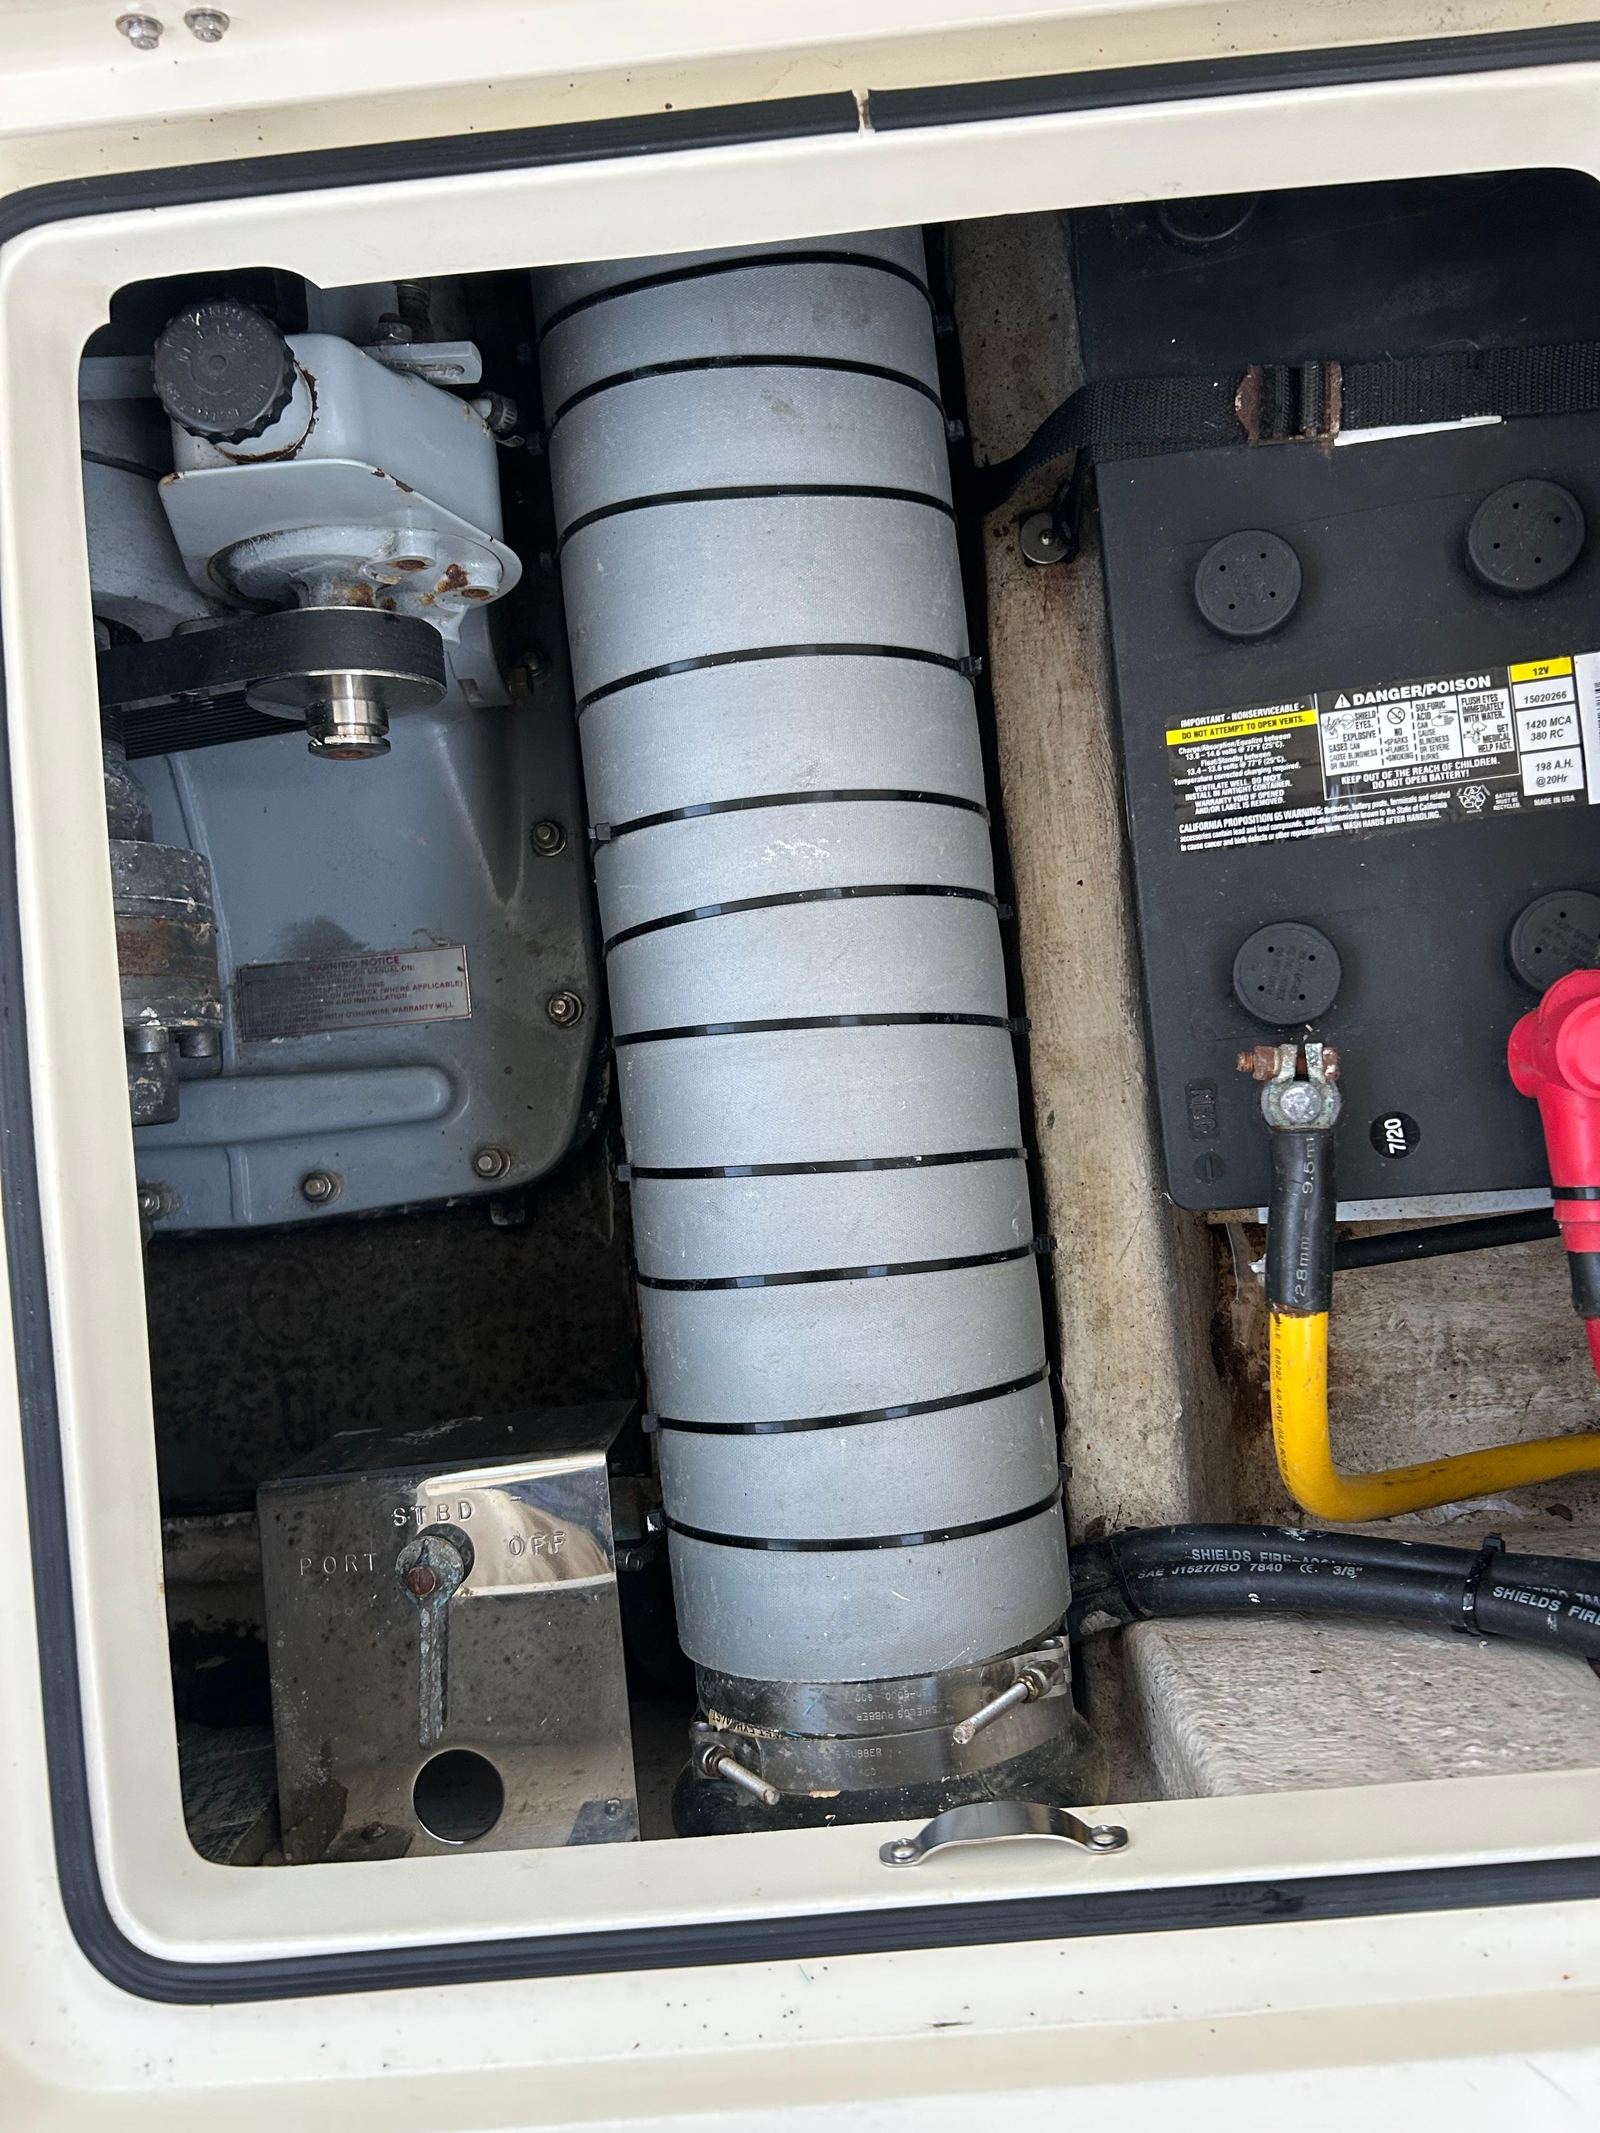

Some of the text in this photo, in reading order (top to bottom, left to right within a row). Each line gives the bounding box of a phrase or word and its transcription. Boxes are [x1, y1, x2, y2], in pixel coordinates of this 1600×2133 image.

[1533, 666, 1549, 676] 12V
[1353, 675, 1491, 706] DANGER/POISON
[1462, 693, 1498, 705] FLUSH EYES
[1524, 691, 1566, 704] 15020266
[1416, 701, 1446, 712] SULFURIC
[1462, 701, 1504, 714] IMMEDIATELY
[1181, 703, 1299, 728] IMPORTANT NONSERVICEABLE
[1355, 710, 1376, 721] SHIELD
[1417, 712, 1431, 721] ACID
[1464, 714, 1483, 723] WITH
[1182, 732, 1191, 740] DO
[1194, 730, 1207, 738] NOT
[1210, 725, 1243, 736] ATTEMPT
[1258, 719, 1277, 728] OPEN
[1280, 715, 1305, 726] VENTS.
[1355, 720, 1373, 730] EYES.
[1497, 724, 1509, 732] GET
[1526, 716, 1572, 731] 1420 MCA
[1343, 730, 1376, 742] EXPLOSIVE
[1530, 729, 1564, 741] 380 RC
[1341, 756, 1500, 785] KEEP OUT OF THE REACH OF CHILDREN.
[1536, 759, 1574, 771] 198 A.H.
[1194, 782, 1229, 792] VENTILATE
[1263, 774, 1282, 782] NOT
[1372, 769, 1469, 790] DO NOT OPEN BATTERY!
[1185, 793, 1212, 801] INSTALL
[1222, 786, 1252, 796] AIRTIGHT
[1195, 797, 1232, 808] WARRANTY
[1232, 794, 1249, 802] VOID
[1258, 790, 1285, 799] OPENED
[1534, 797, 1552, 806] MADE
[1562, 794, 1575, 803] USA
[1195, 807, 1220, 815] AND/OR
[1222, 804, 1241, 812] LABEL
[1179, 820, 1222, 834] CALIFORNIA
[1223, 813, 1273, 828] PROPOSITION
[1274, 812, 1283, 821] 65
[1283, 806, 1323, 820] WARNING:
[1343, 820, 1362, 830] WASH
[1363, 818, 1384, 827] HANDS
[1386, 815, 1406, 826] AFTER
[361, 956, 399, 967] NOTICE
[1384, 1118, 1406, 1154] 7/20
[391, 1501, 474, 1526] STBD
[508, 1530, 566, 1557] OFF
[1192, 1549, 1251, 1562] SHIELDS
[299, 1552, 377, 1576] PORT
[1171, 1563, 1240, 1575] J1527/ISO
[1250, 1563, 1283, 1572] 7840
[1493, 1586, 1562, 1611] SHIELDS
[845, 1747, 882, 1759] RUBBER
